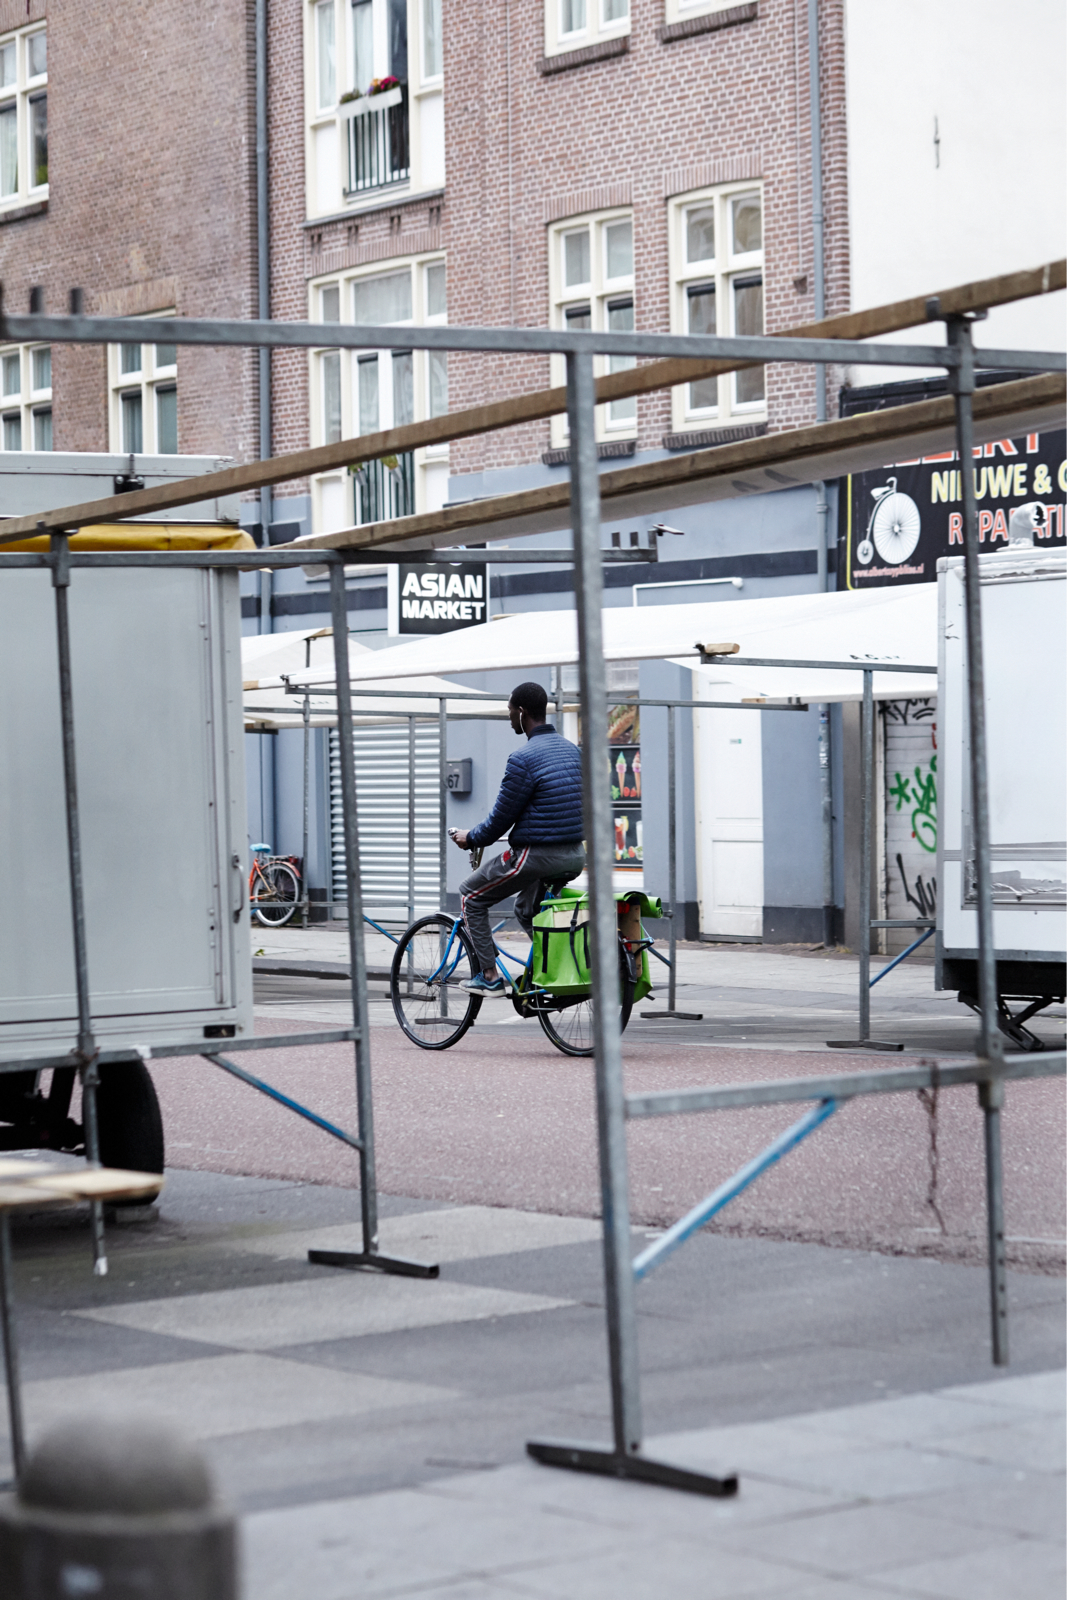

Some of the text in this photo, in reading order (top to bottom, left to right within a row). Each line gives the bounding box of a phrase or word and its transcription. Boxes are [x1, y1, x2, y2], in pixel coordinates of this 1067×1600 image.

[931, 463, 1028, 504] NIUWE
[1033, 464, 1052, 495] &
[401, 572, 483, 598] ASIAN
[402, 600, 485, 620] MARKET
